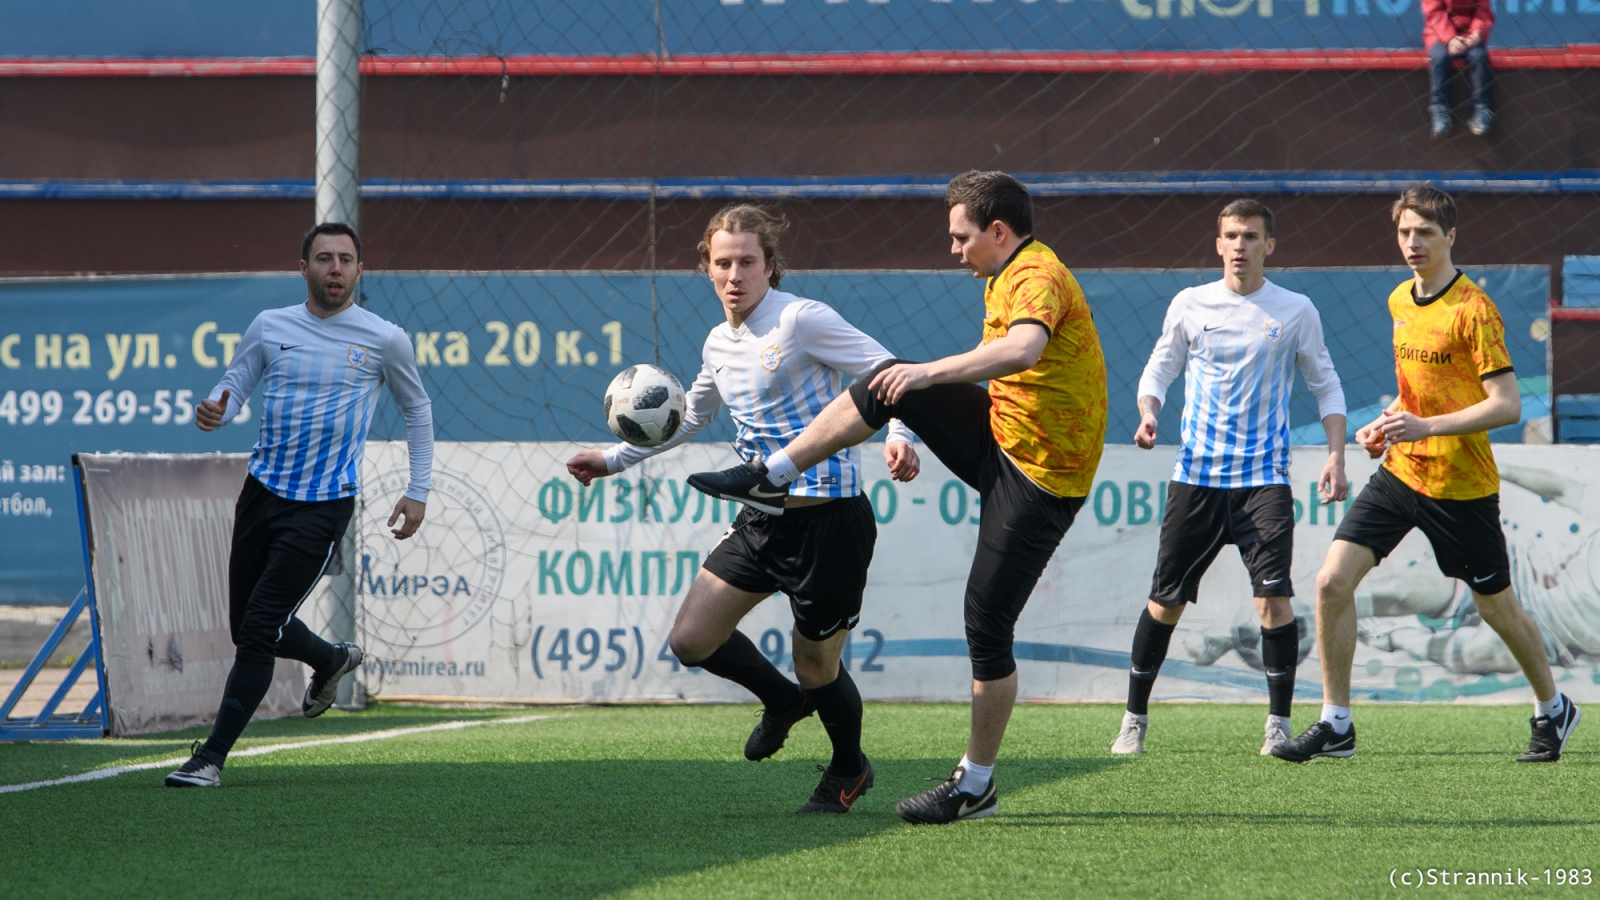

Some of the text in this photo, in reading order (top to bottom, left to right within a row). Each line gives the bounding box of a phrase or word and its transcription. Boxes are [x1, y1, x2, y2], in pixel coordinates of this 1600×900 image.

[35, 332, 91, 369] на
[105, 332, 178, 381] ул.
[484, 320, 541, 367] 20
[0, 389, 63, 425] 499
[19, 464, 66, 483] зал:
[0, 491, 53, 518] тбол,
[538, 550, 712, 596] КОМПЛ
[531, 625, 644, 680] (495)
